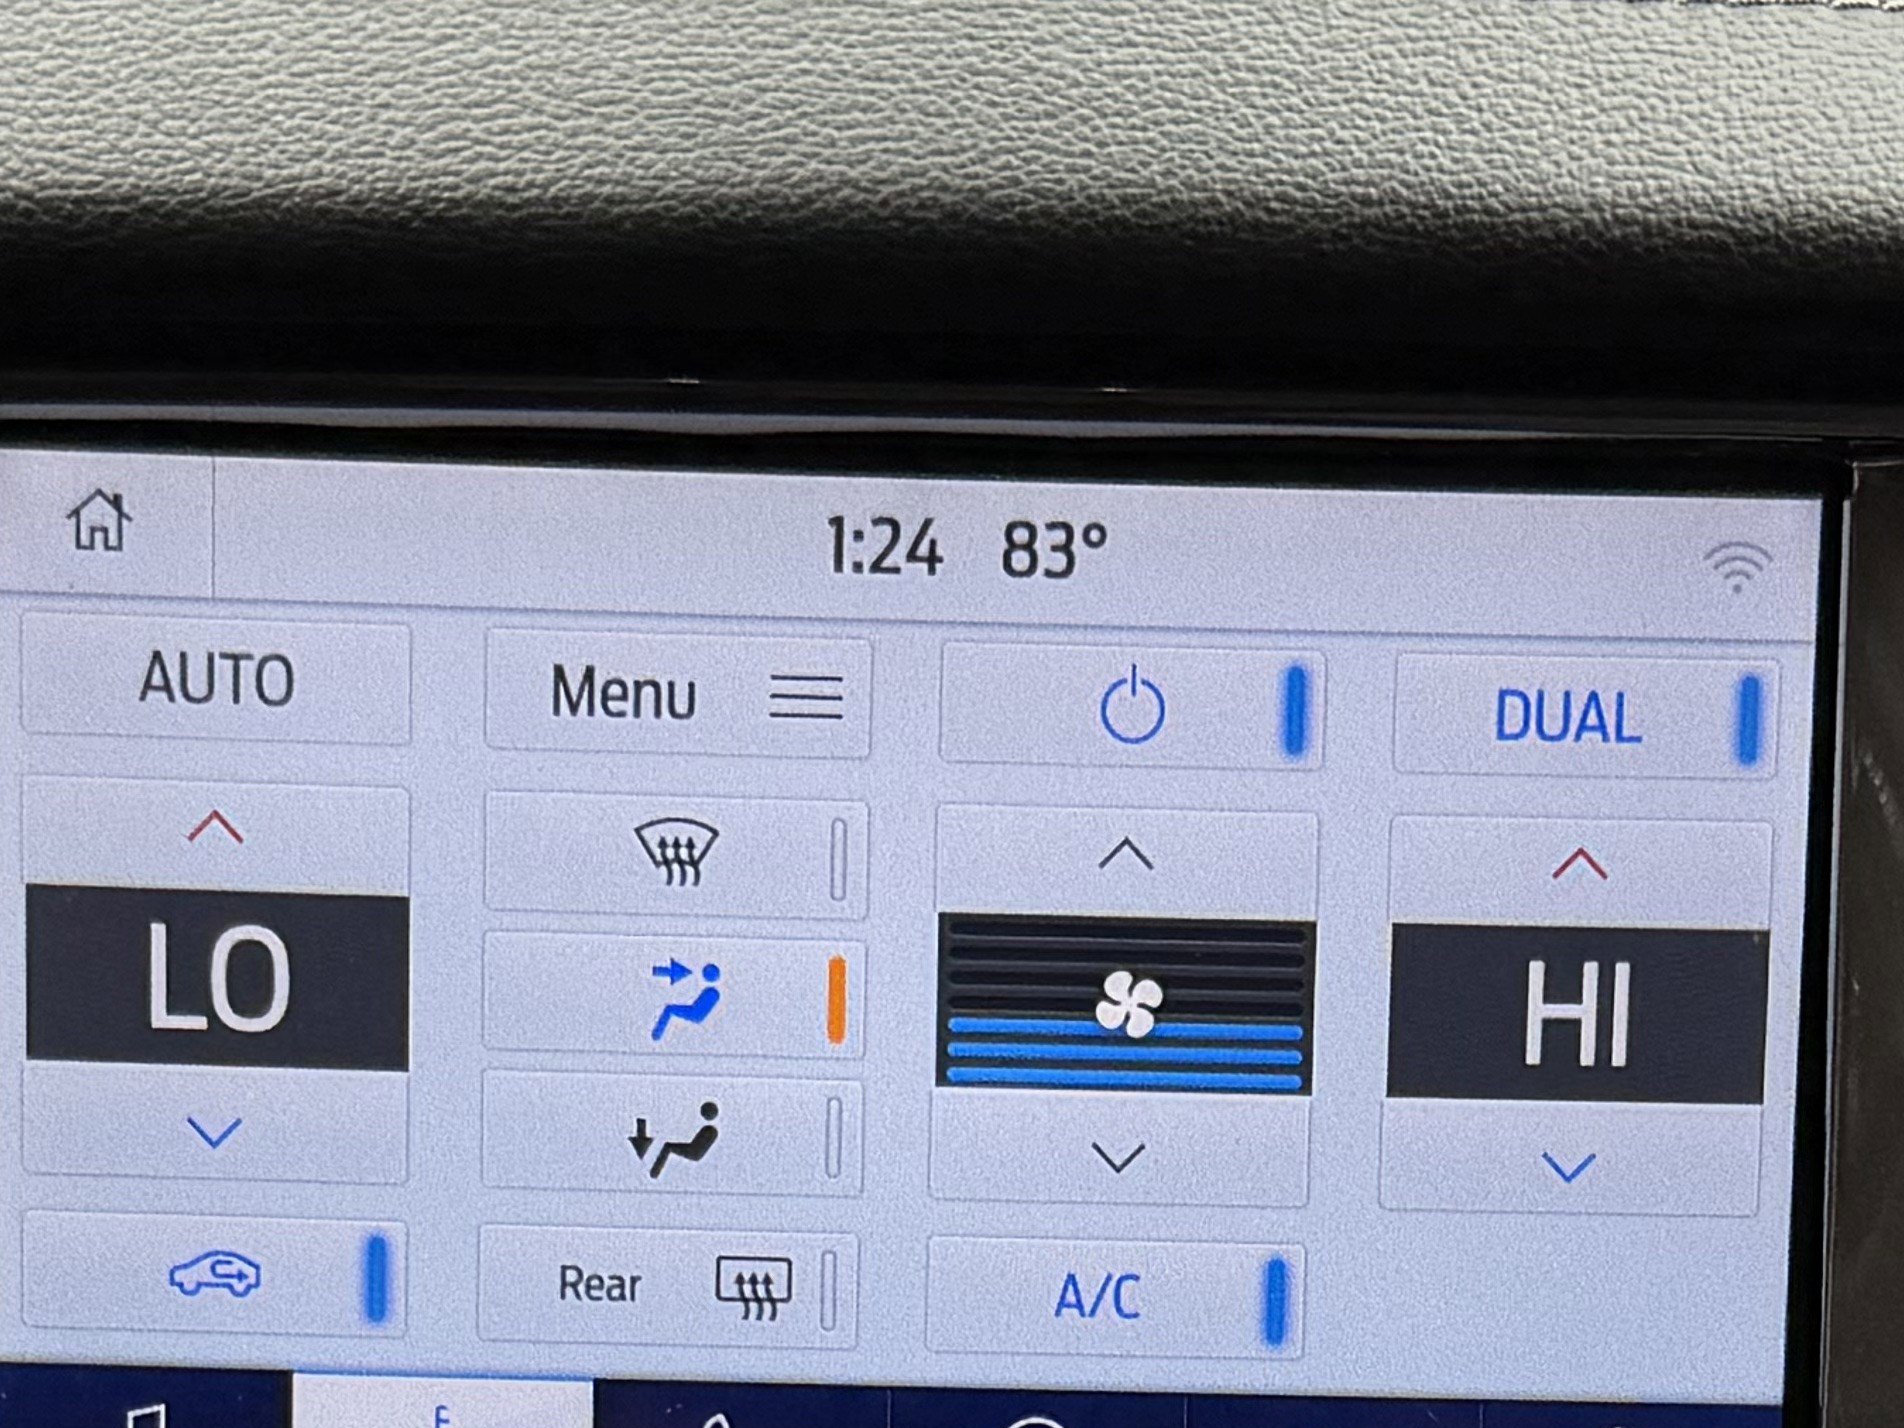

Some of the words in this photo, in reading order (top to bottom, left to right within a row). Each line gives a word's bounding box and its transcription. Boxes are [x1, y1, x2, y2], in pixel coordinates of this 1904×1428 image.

[827, 514, 944, 576] 1:24
[1002, 519, 1108, 580] 83°
[138, 649, 295, 707] AUTO
[552, 663, 697, 721] Menu
[1496, 688, 1644, 744] DUAL
[149, 921, 291, 1033] LO
[1525, 959, 1631, 1067] HI
[559, 1264, 642, 1303] Rear
[1054, 1272, 1142, 1320] A/C
